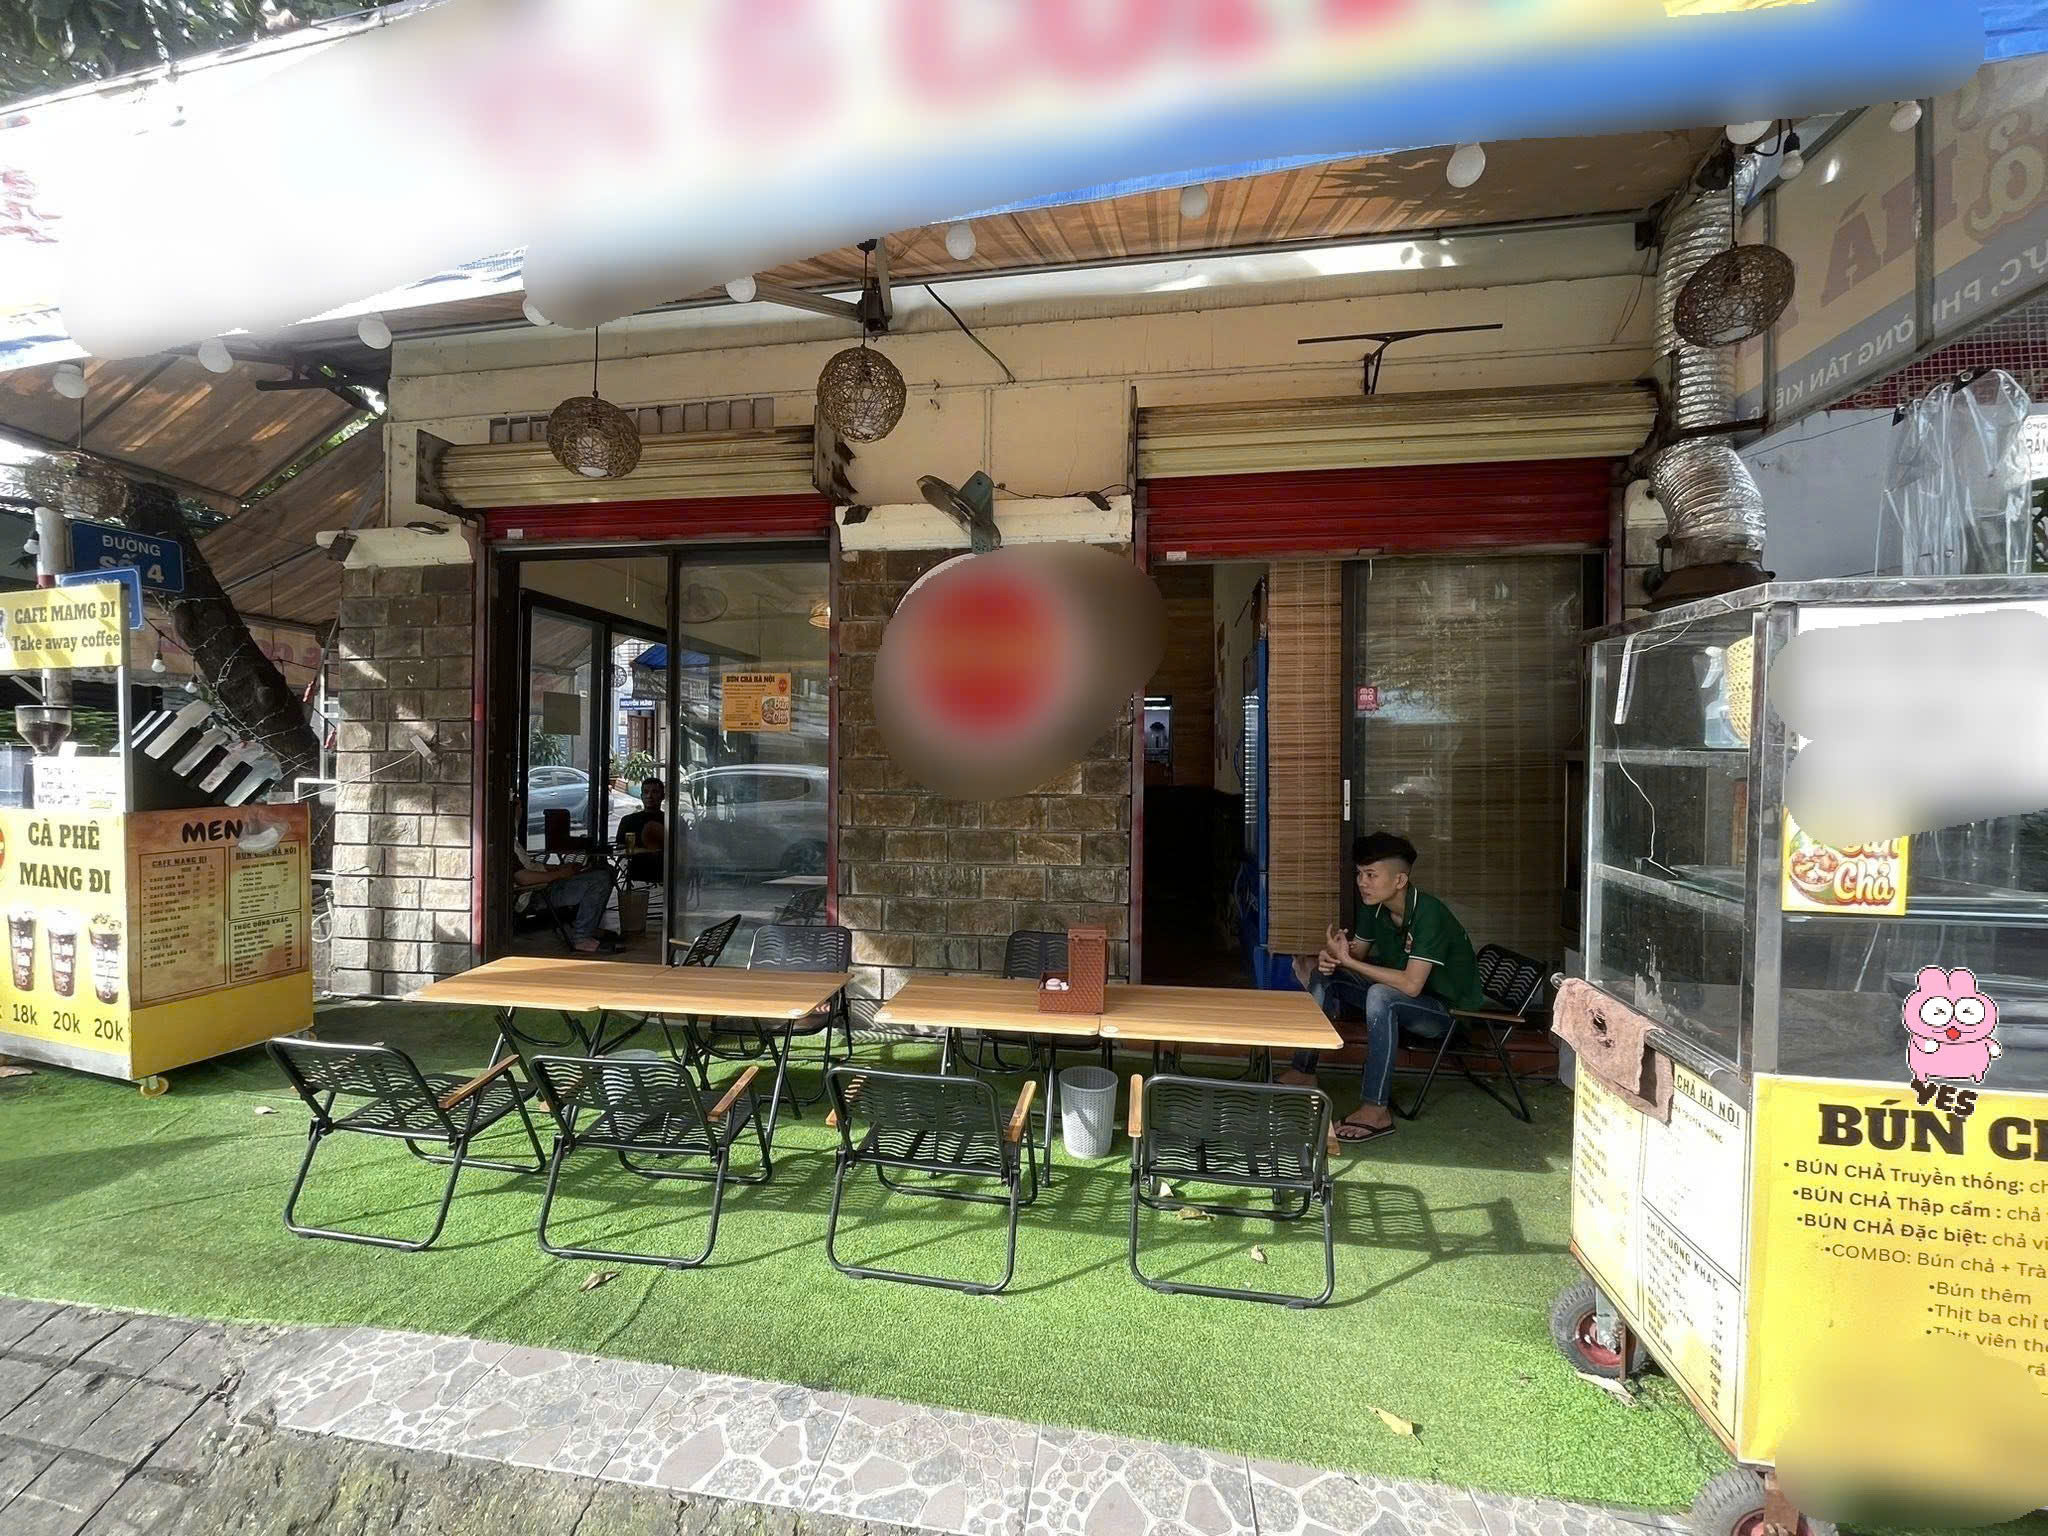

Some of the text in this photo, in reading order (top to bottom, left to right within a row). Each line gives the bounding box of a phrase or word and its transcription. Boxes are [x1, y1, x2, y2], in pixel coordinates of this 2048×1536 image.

[102, 534, 161, 557] ĐƯỜNG
[147, 563, 164, 583] 4
[15, 606, 48, 624] CAFE
[100, 600, 116, 618] ĐI
[11, 634, 42, 651] Take
[45, 636, 77, 652] away
[81, 630, 120, 648] coffee
[28, 817, 100, 851] CÀ PHÊ
[182, 819, 243, 843] MEN
[19, 862, 112, 895] MANG ĐI
[1834, 860, 1896, 905] Chả
[13, 1003, 38, 1026] 18k
[52, 1010, 81, 1034] 20k
[94, 1018, 124, 1042] 20k
[1677, 1074, 1741, 1127] CHẢ HÀ NỘI
[1818, 1099, 1967, 1156] BÚN
[1795, 1157, 1838, 1177] BÚN
[1844, 1162, 1886, 1181] CHẢ
[1890, 1166, 1956, 1188] Truyền
[1961, 1171, 2024, 1196] thống:
[1800, 1186, 1843, 1204] BÚN
[1849, 1190, 1892, 1210] CHẢ
[1896, 1195, 1944, 1217] Thập
[2006, 1206, 2041, 1222] chả
[1804, 1211, 1847, 1231] BÚN
[1853, 1217, 1895, 1236] CHẢ
[1901, 1223, 1938, 1242] Đặc
[1943, 1227, 1987, 1247] biệt:
[1992, 1232, 2026, 1248] chả
[1832, 1243, 1912, 1264] COMBO:
[1917, 1252, 1955, 1269] Bún
[1960, 1257, 1994, 1273] chả
[2016, 1262, 2047, 1279] Trà
[1936, 1281, 2032, 1305] Bún thêm
[1934, 1303, 1972, 1323] Thịt
[1978, 1309, 2002, 1325] ba
[2007, 1313, 2038, 1329] chỉ
[1976, 1332, 2017, 1349] viên
[2023, 1338, 2048, 1353] th
